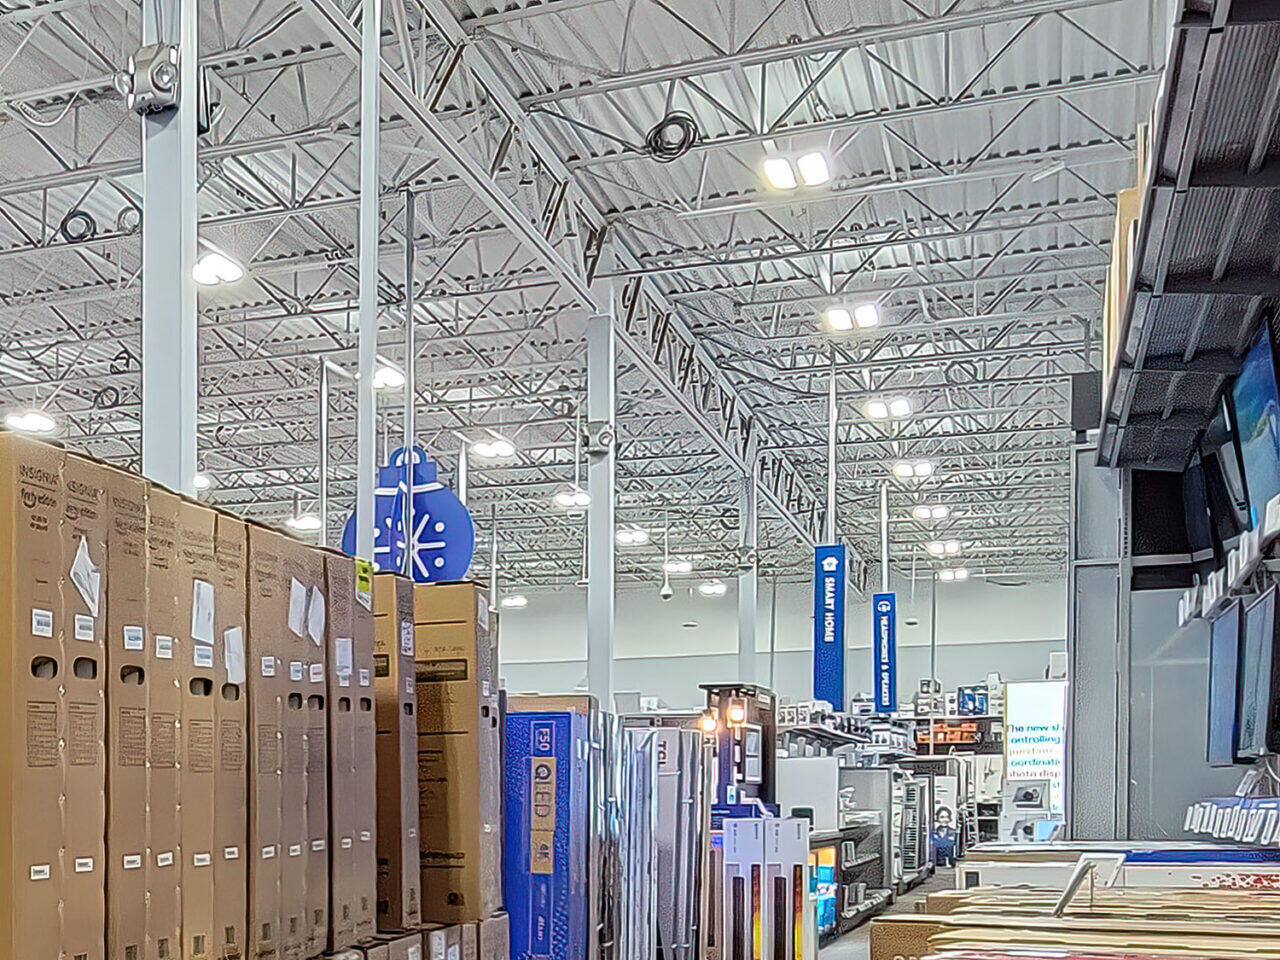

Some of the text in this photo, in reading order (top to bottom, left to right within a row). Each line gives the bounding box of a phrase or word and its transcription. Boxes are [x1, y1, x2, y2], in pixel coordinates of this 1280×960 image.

[824, 576, 836, 643] SMART HOME
[657, 740, 667, 768] TCL
[535, 763, 551, 818] QLED
